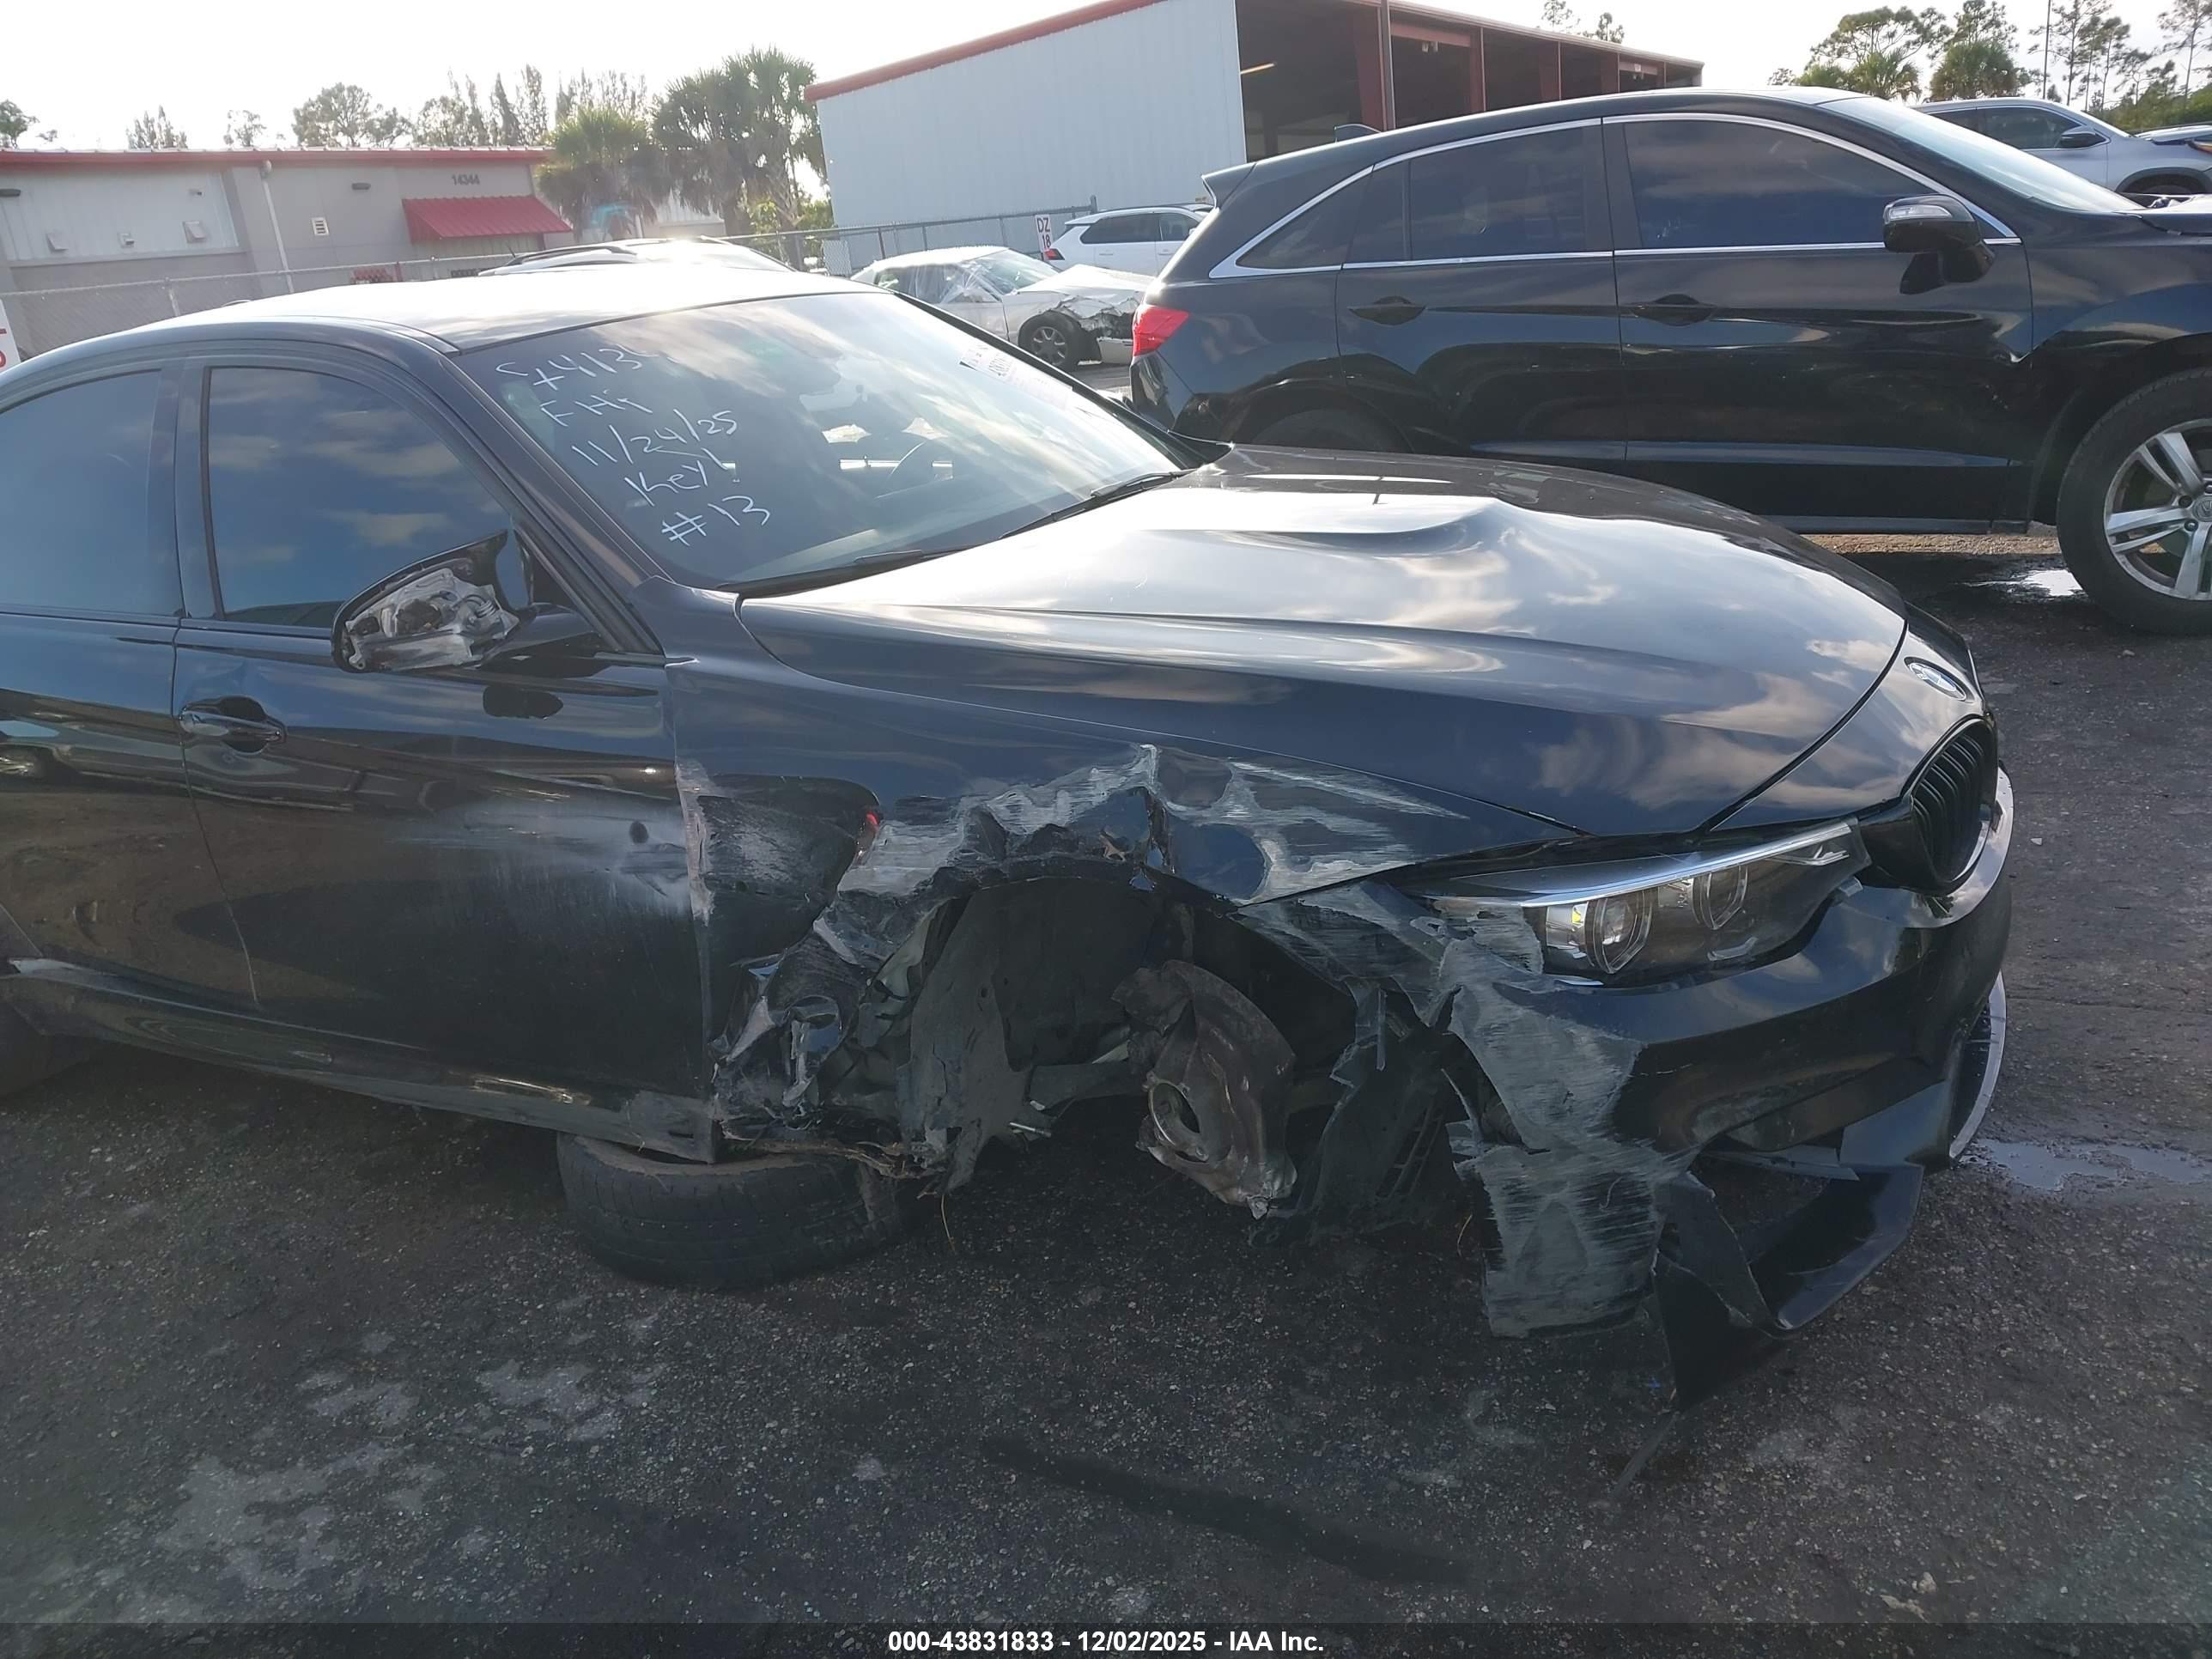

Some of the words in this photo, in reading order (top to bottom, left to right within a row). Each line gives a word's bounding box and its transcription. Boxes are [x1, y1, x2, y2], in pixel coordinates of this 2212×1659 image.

[1036, 216, 1051, 233] DZ
[1042, 234, 1052, 249] 18
[571, 408, 738, 466] 11/24/25
